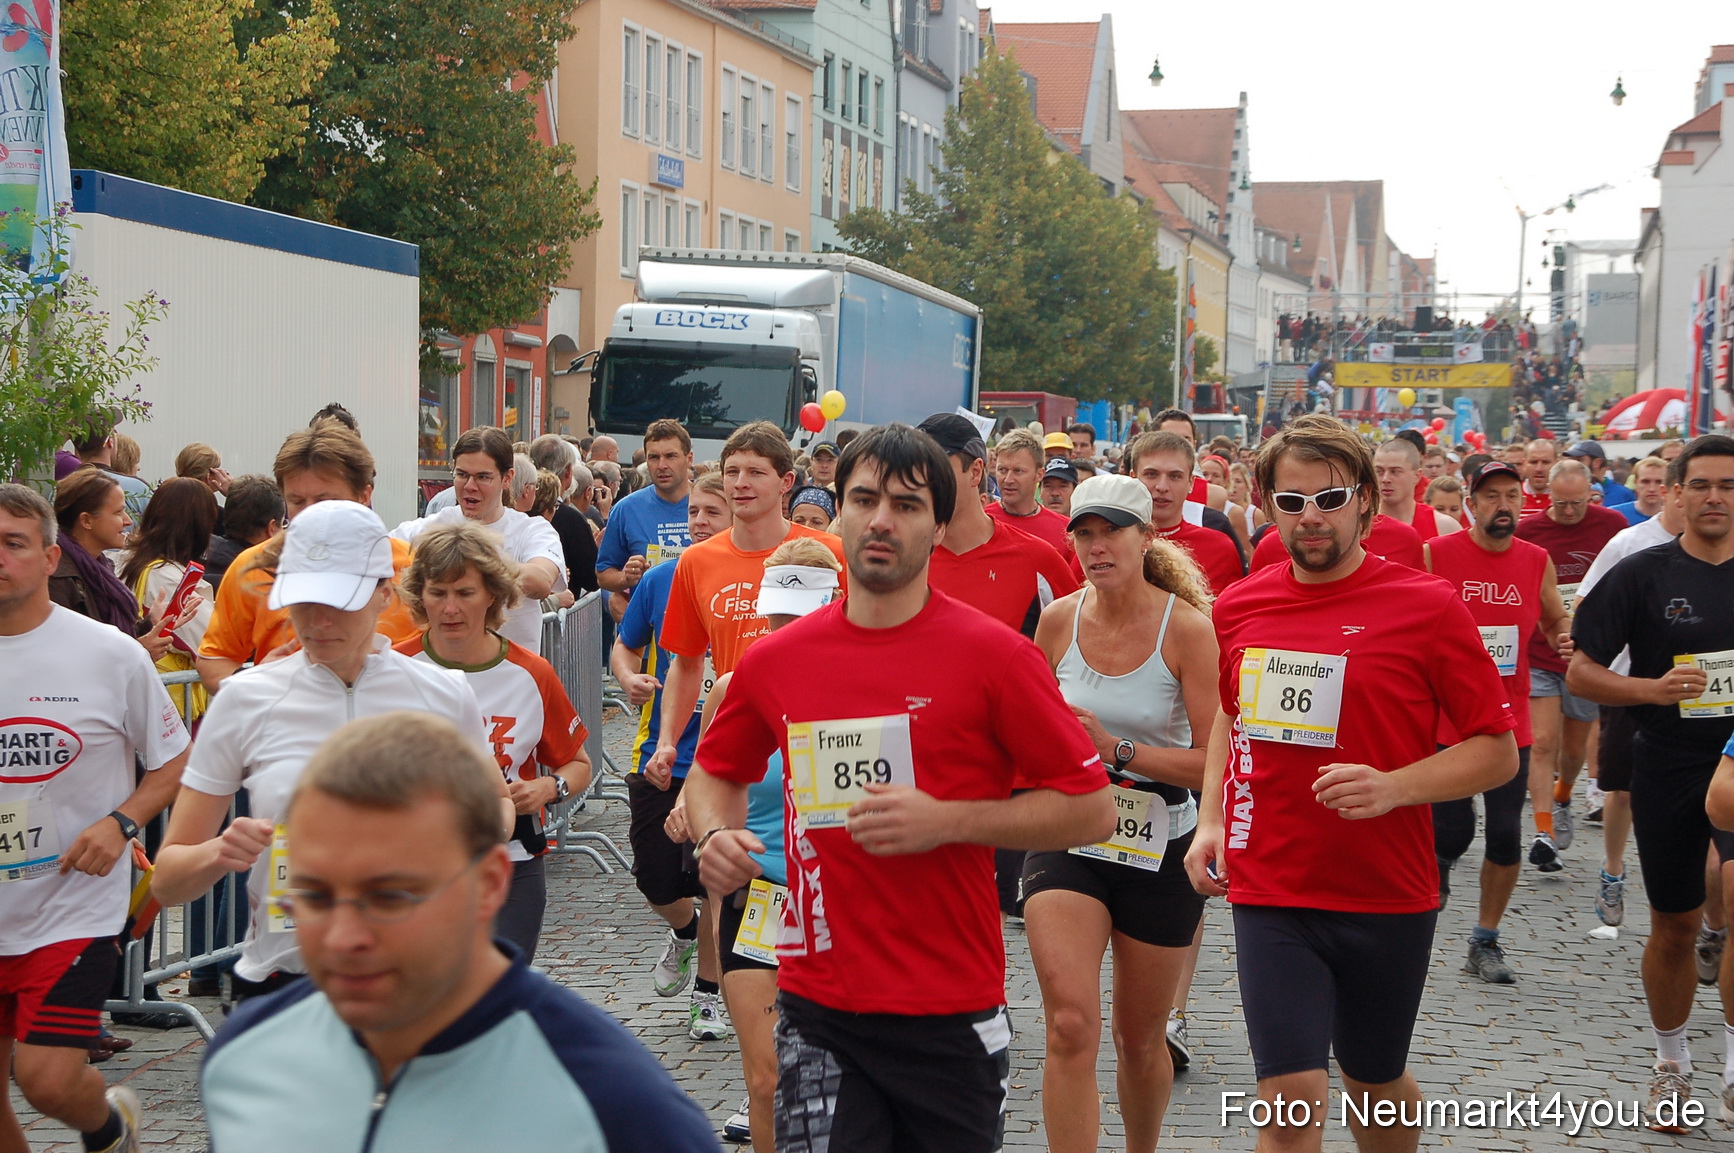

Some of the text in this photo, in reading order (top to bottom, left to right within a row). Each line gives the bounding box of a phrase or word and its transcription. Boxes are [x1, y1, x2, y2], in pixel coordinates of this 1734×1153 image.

[655, 310, 749, 330] BOCK
[1391, 369, 1451, 382] START
[1462, 580, 1522, 606] FILA
[1266, 656, 1333, 679] Alexander
[1697, 659, 1734, 670] Thoma
[1280, 686, 1313, 713] 86
[818, 730, 862, 749] Franz
[1293, 730, 1334, 741] PFLEIDERER
[834, 758, 892, 790] 859
[1228, 778, 1254, 849] MAX
[1128, 854, 1160, 866] PFLEIDERER
[804, 864, 832, 953] MAX
